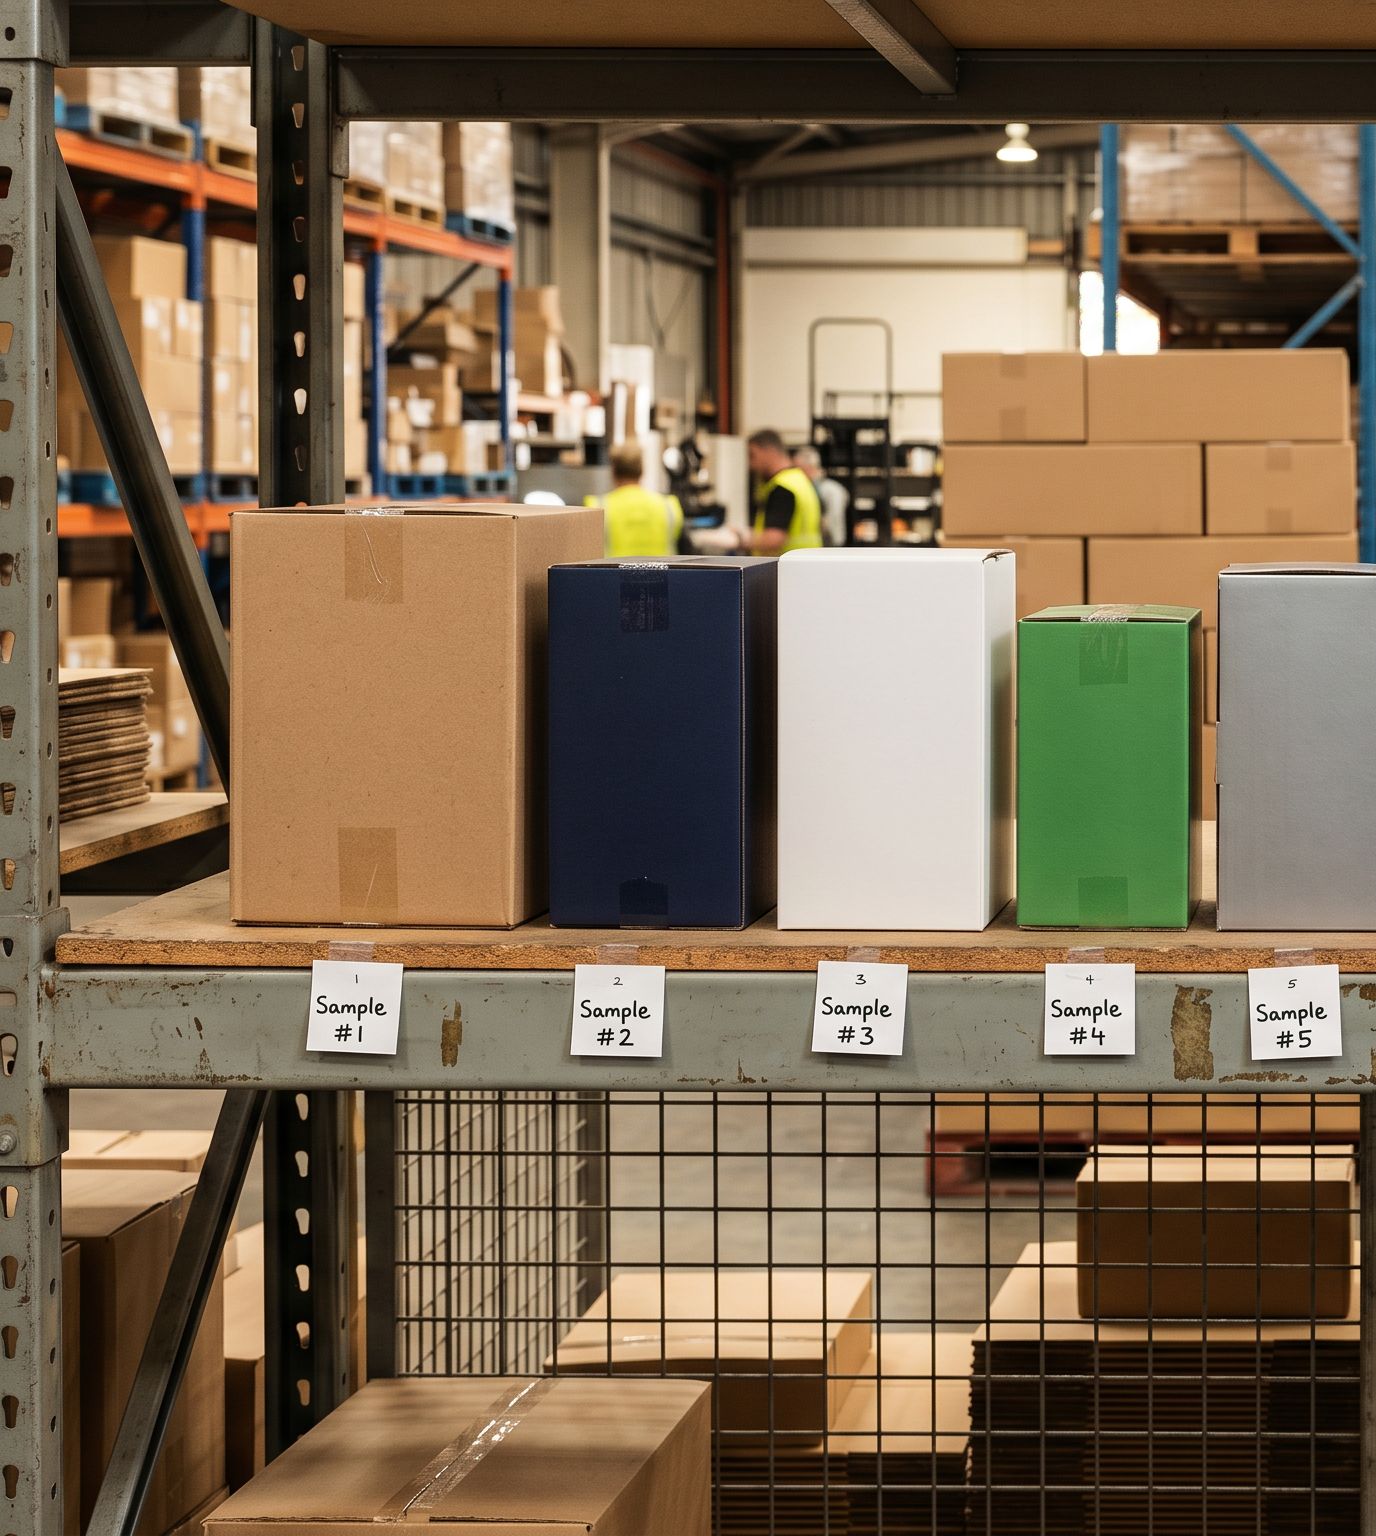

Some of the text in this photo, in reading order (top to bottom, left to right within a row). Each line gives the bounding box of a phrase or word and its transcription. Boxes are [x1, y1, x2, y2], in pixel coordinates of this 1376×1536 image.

[614, 974, 624, 985] 2
[856, 974, 867, 985] 3
[1086, 974, 1095, 985] 4
[1287, 978, 1297, 989] 5
[316, 995, 388, 1022] Sample
[580, 1000, 651, 1025] Sample
[821, 996, 892, 1023] Sample
[1051, 998, 1122, 1024] Sample
[1256, 1001, 1328, 1027] Sample
[334, 1023, 363, 1043] #1
[596, 1027, 634, 1047] #2
[837, 1025, 874, 1044] #3
[1069, 1026, 1106, 1046] #4
[1276, 1029, 1312, 1049] #5
